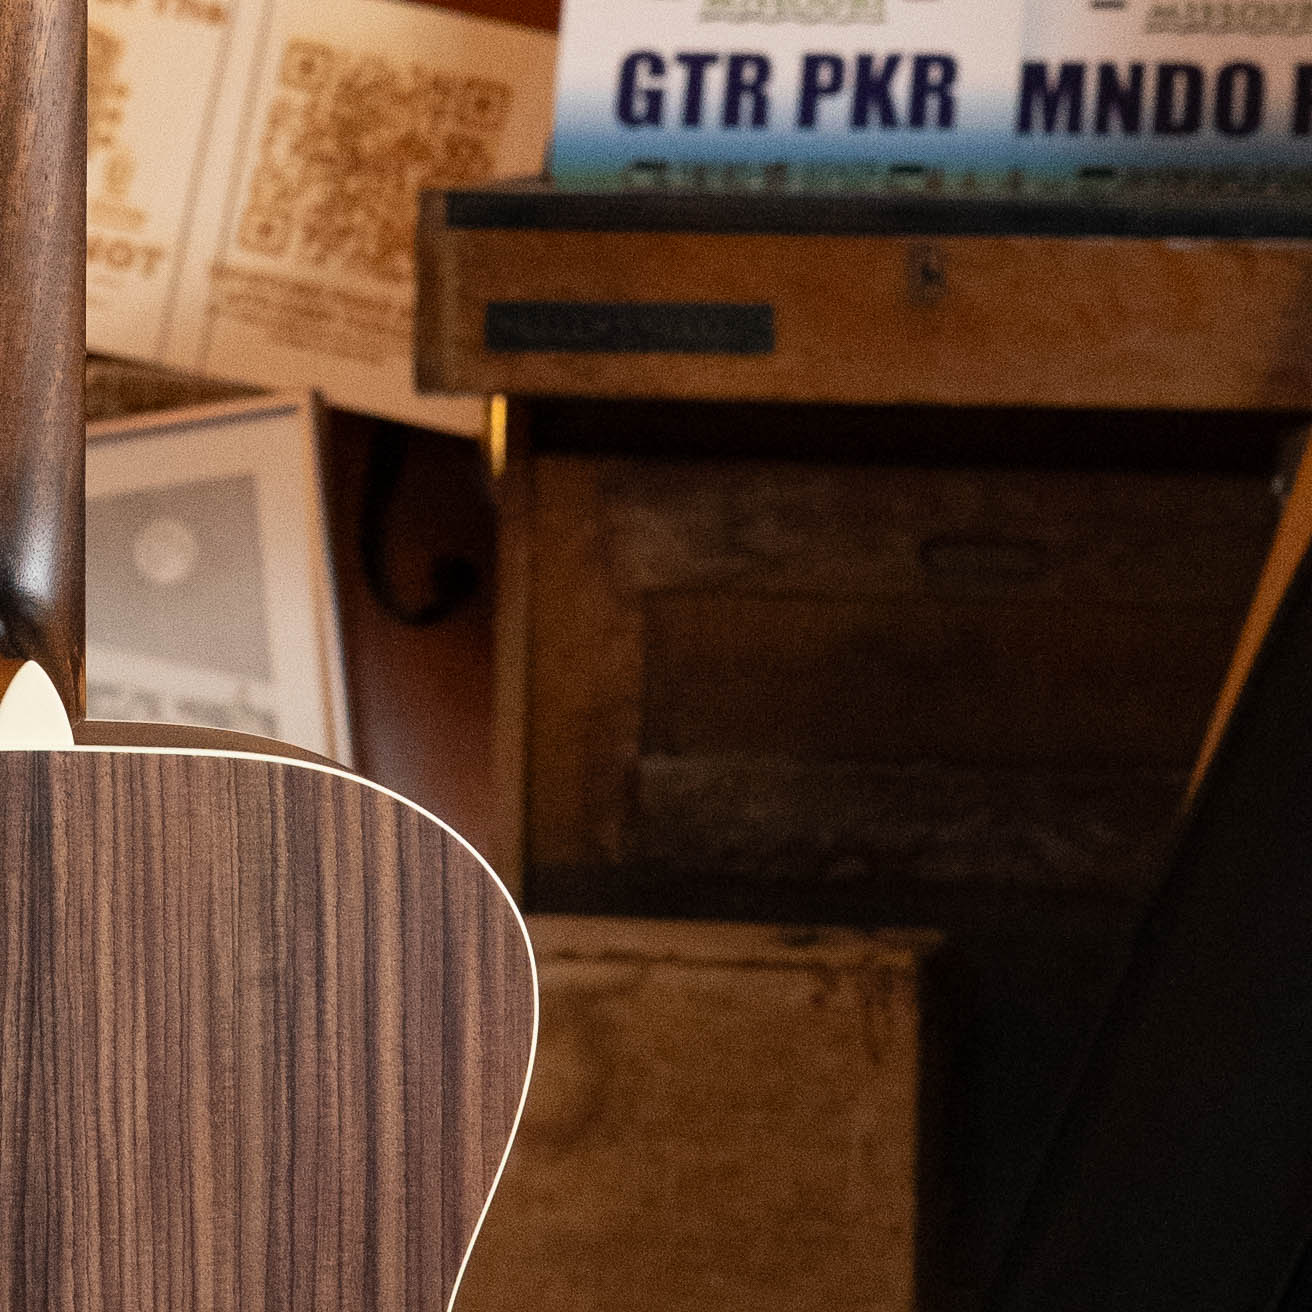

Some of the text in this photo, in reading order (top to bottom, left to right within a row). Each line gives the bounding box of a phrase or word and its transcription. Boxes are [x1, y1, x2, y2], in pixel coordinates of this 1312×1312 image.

[616, 49, 959, 131] GTR PKR
[1015, 60, 1265, 135] MNDO
